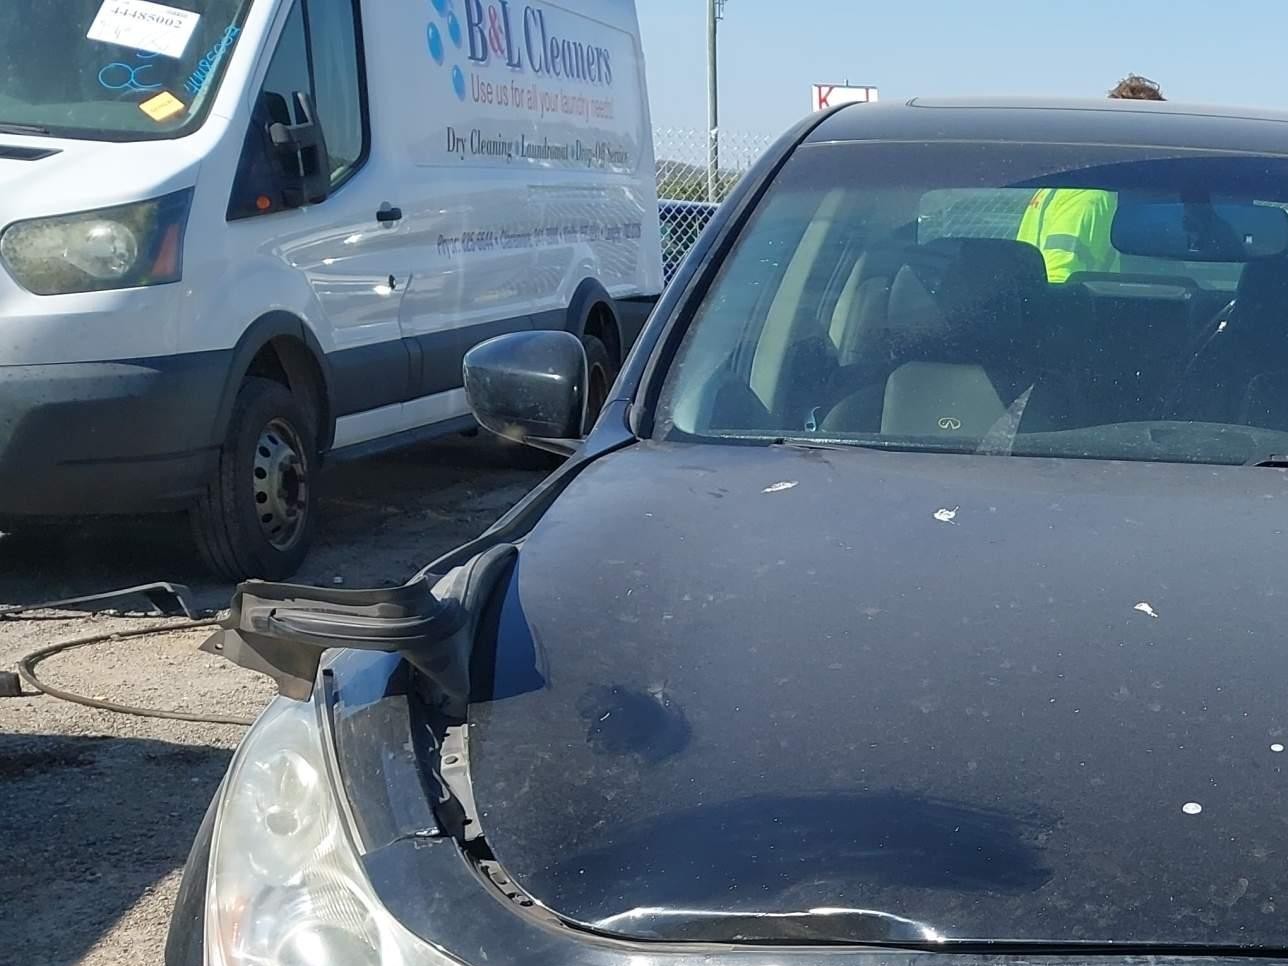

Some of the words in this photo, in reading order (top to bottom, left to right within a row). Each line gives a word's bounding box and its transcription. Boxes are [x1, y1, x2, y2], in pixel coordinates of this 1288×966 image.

[111, 7, 183, 29] 44485002
[465, 0, 521, 68] B&L
[524, 6, 612, 85] Cleaners
[471, 73, 493, 105] Use
[497, 82, 509, 107] us
[511, 80, 525, 110] for
[527, 84, 538, 112] all
[539, 88, 559, 119] your
[446, 127, 466, 160] Dry
[470, 128, 513, 164] Cleaning
[521, 134, 569, 160] Laundromat
